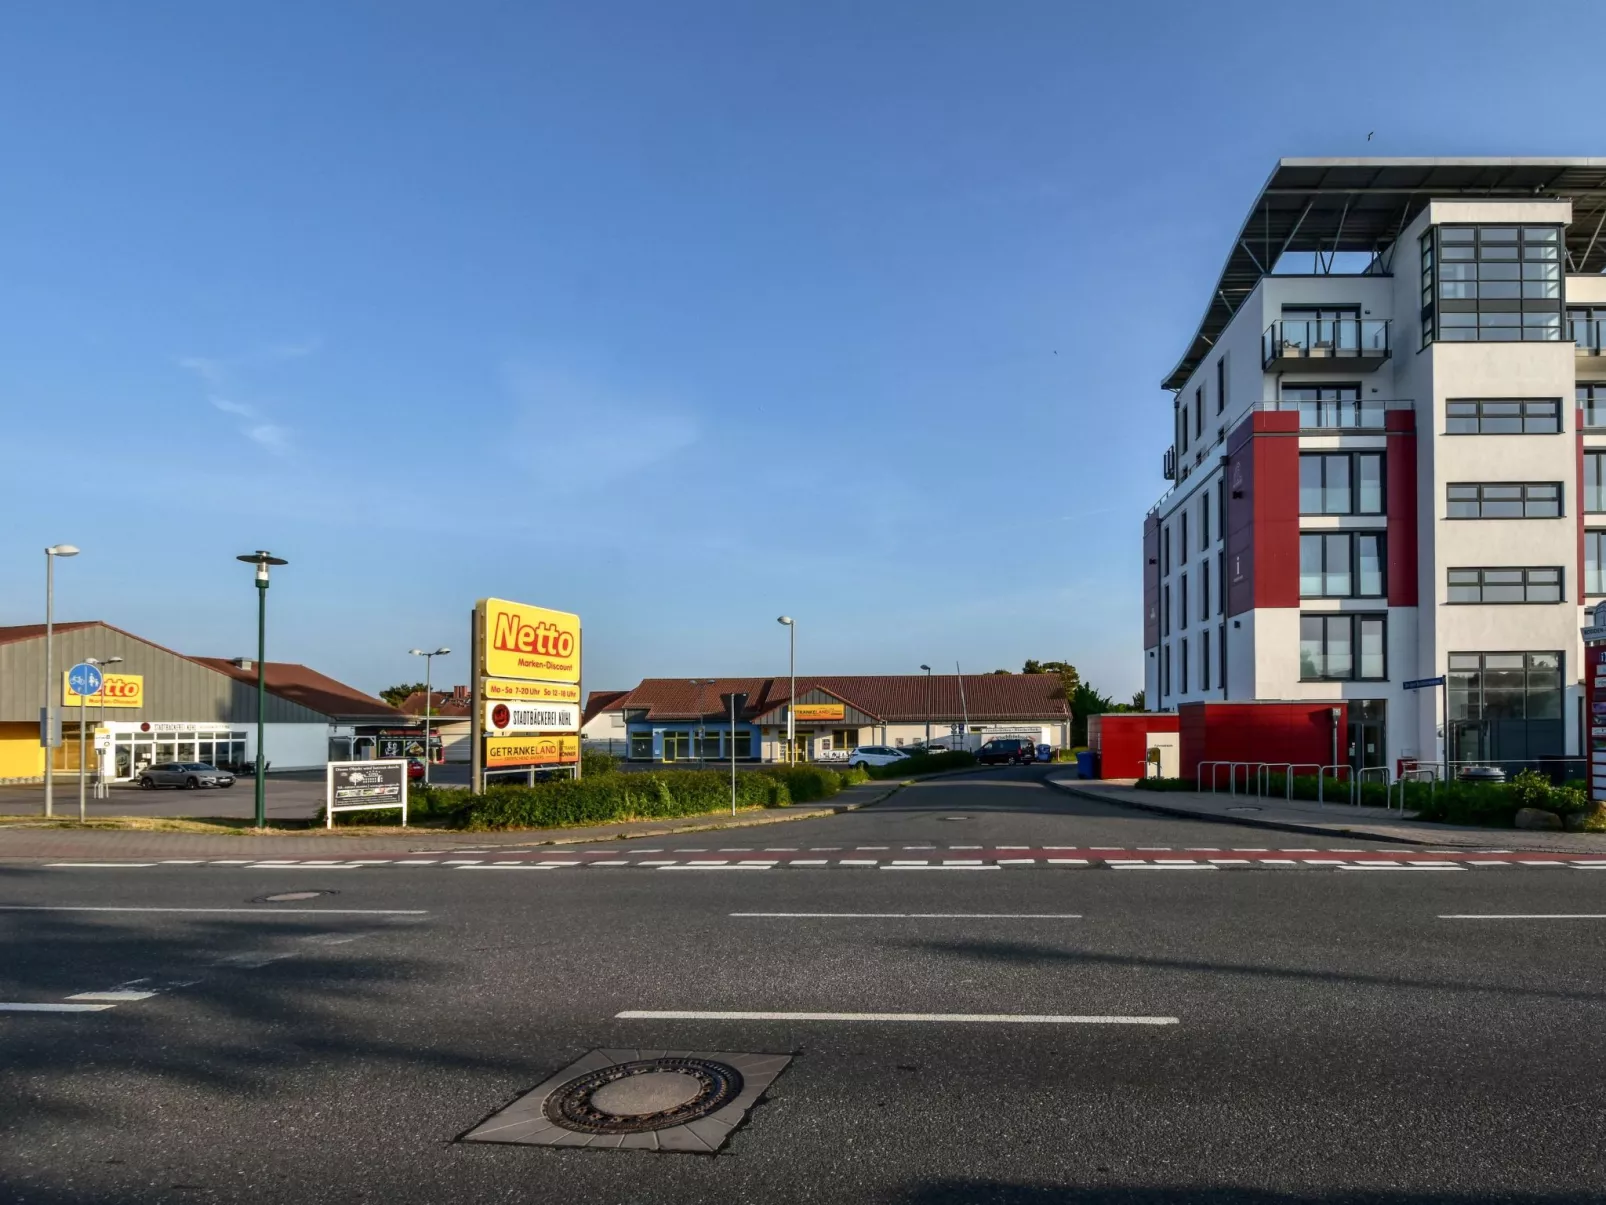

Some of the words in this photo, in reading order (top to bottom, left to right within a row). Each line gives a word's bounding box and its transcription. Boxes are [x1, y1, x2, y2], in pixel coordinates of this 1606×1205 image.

[493, 612, 574, 658] Netto
[518, 658, 573, 671] Marken-Discount
[68, 678, 140, 698] tto
[530, 687, 541, 696] Uhr
[544, 688, 552, 696] So
[567, 690, 577, 698] Uhr
[513, 708, 557, 726] STADTBÄCKEREI
[558, 709, 572, 726] KÜHL
[490, 744, 557, 757] GETRÄNKELAND
